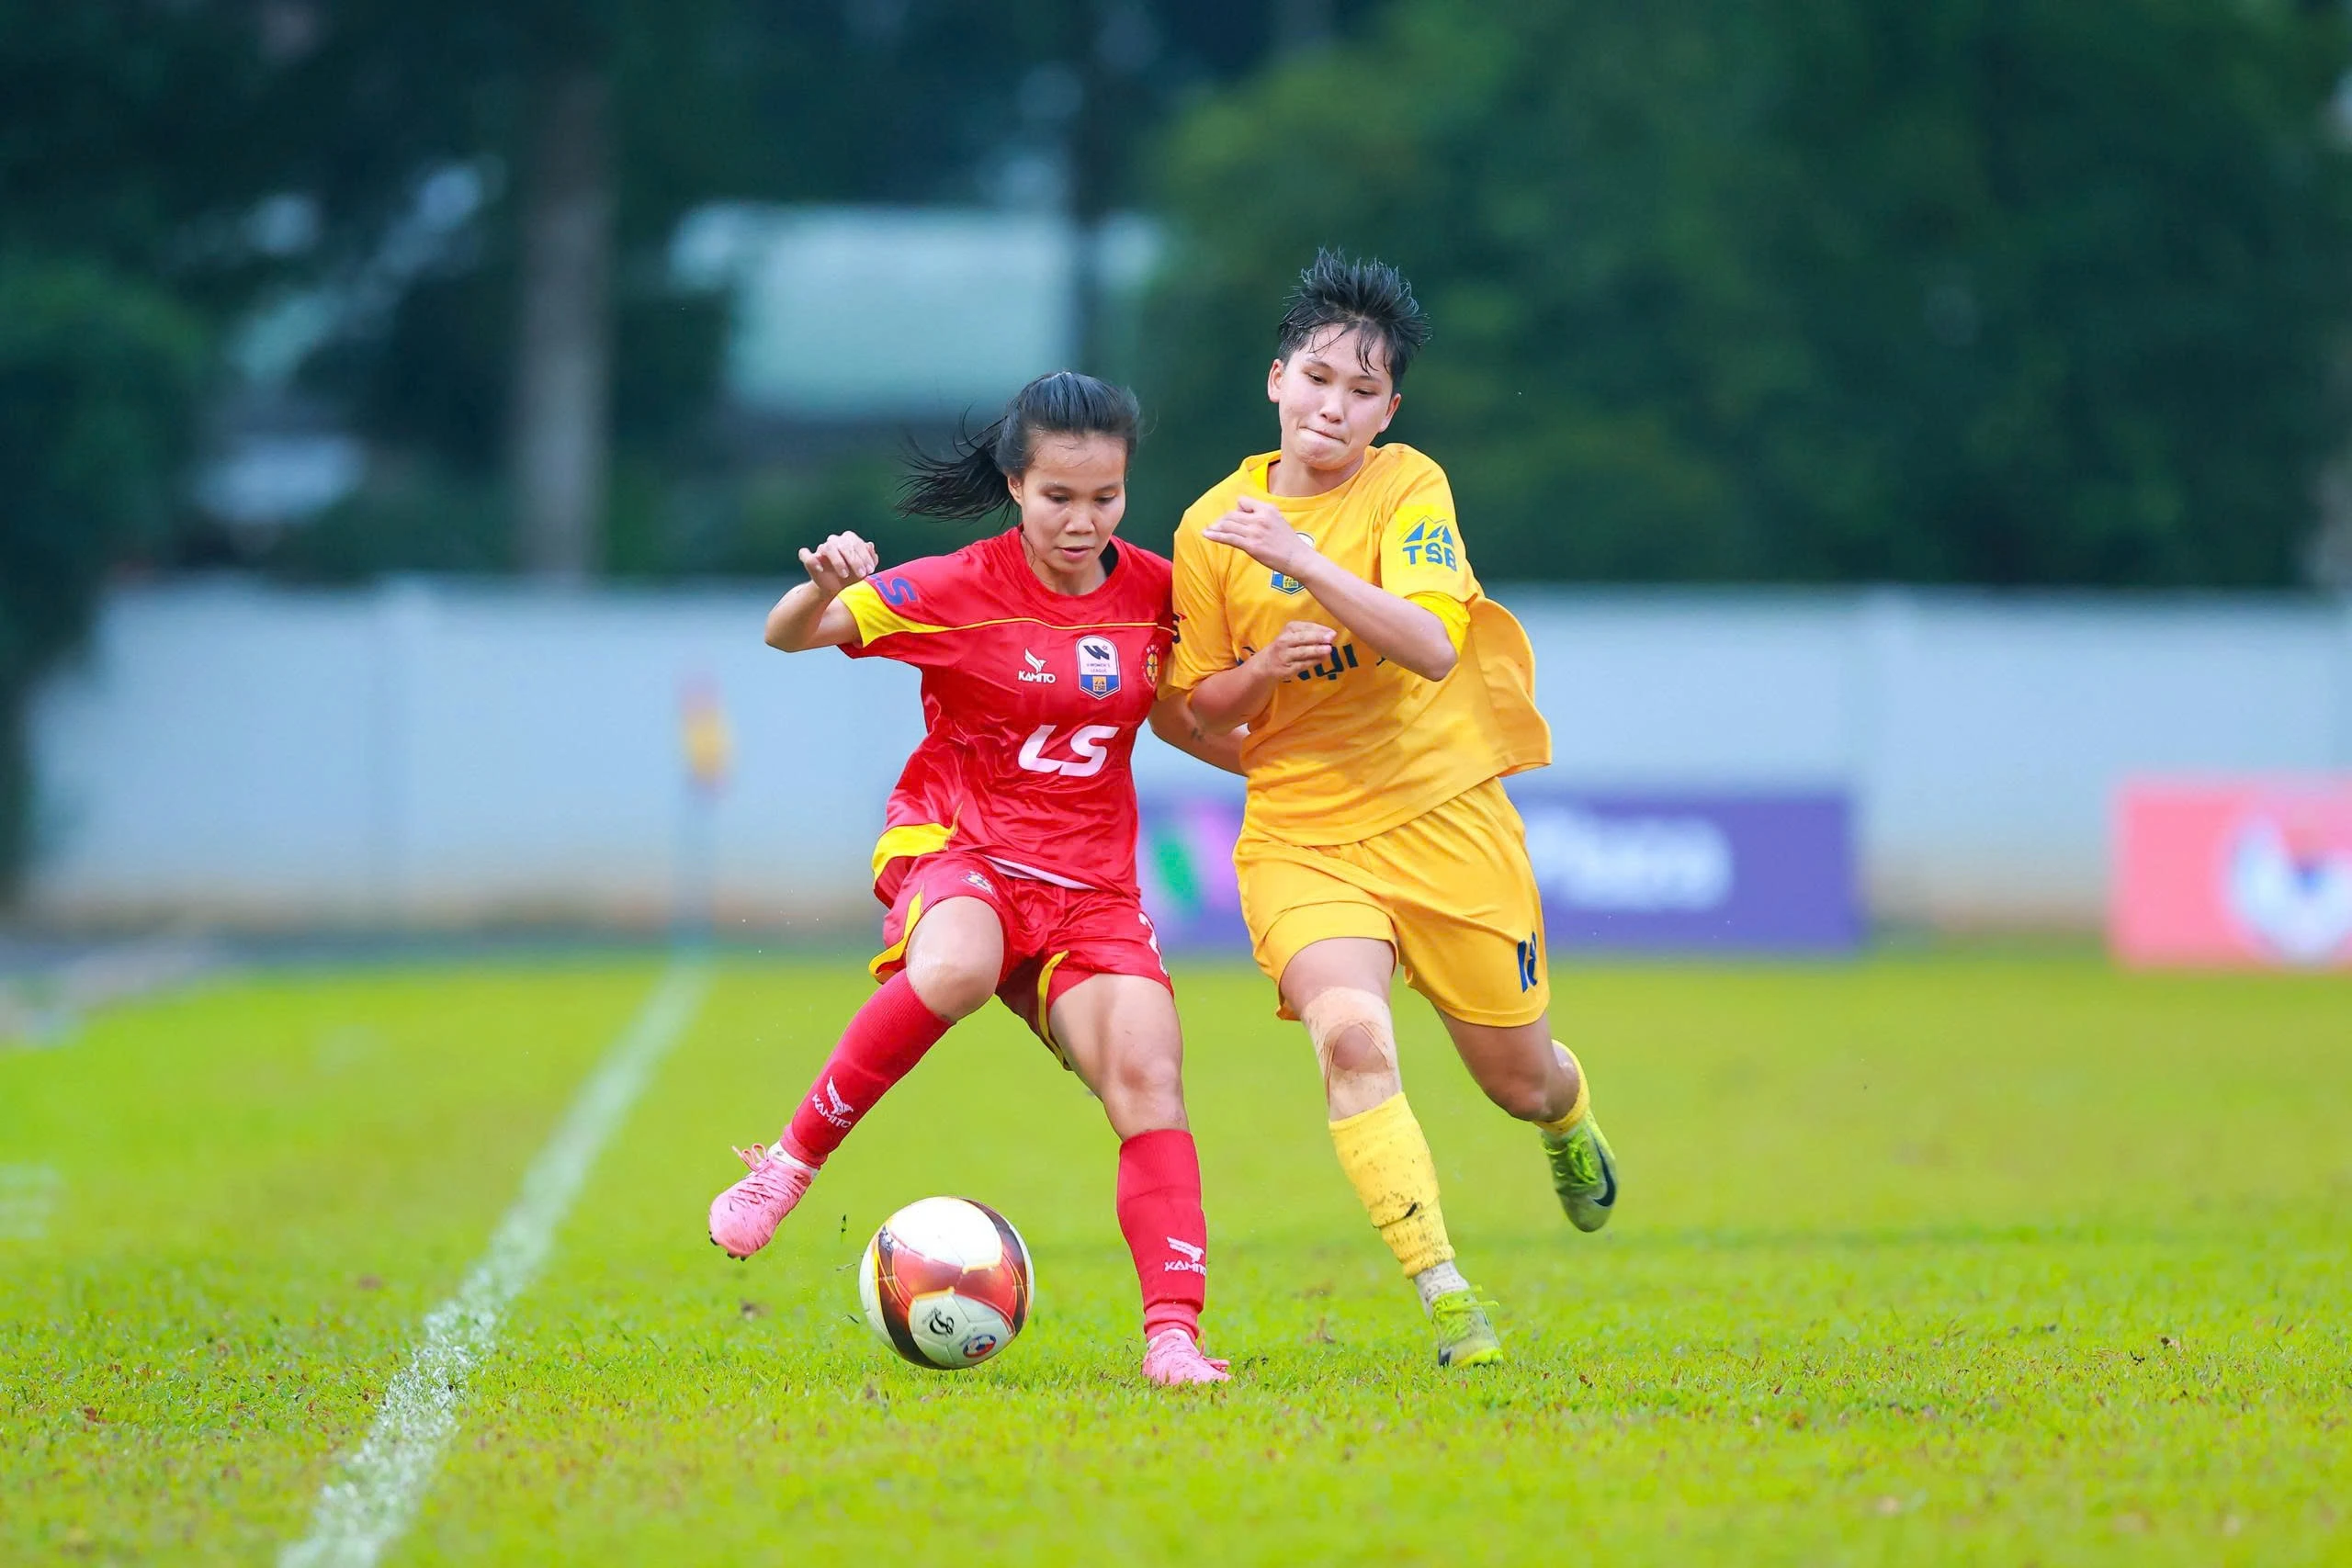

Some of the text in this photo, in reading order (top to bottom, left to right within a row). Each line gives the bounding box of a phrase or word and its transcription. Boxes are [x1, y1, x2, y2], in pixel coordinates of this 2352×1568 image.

[1403, 542, 1457, 571] TSB
[869, 575, 917, 604] S
[1018, 670, 1056, 683] KAMITO
[1018, 725, 1120, 777] LS
[811, 1093, 852, 1128] KAMITO
